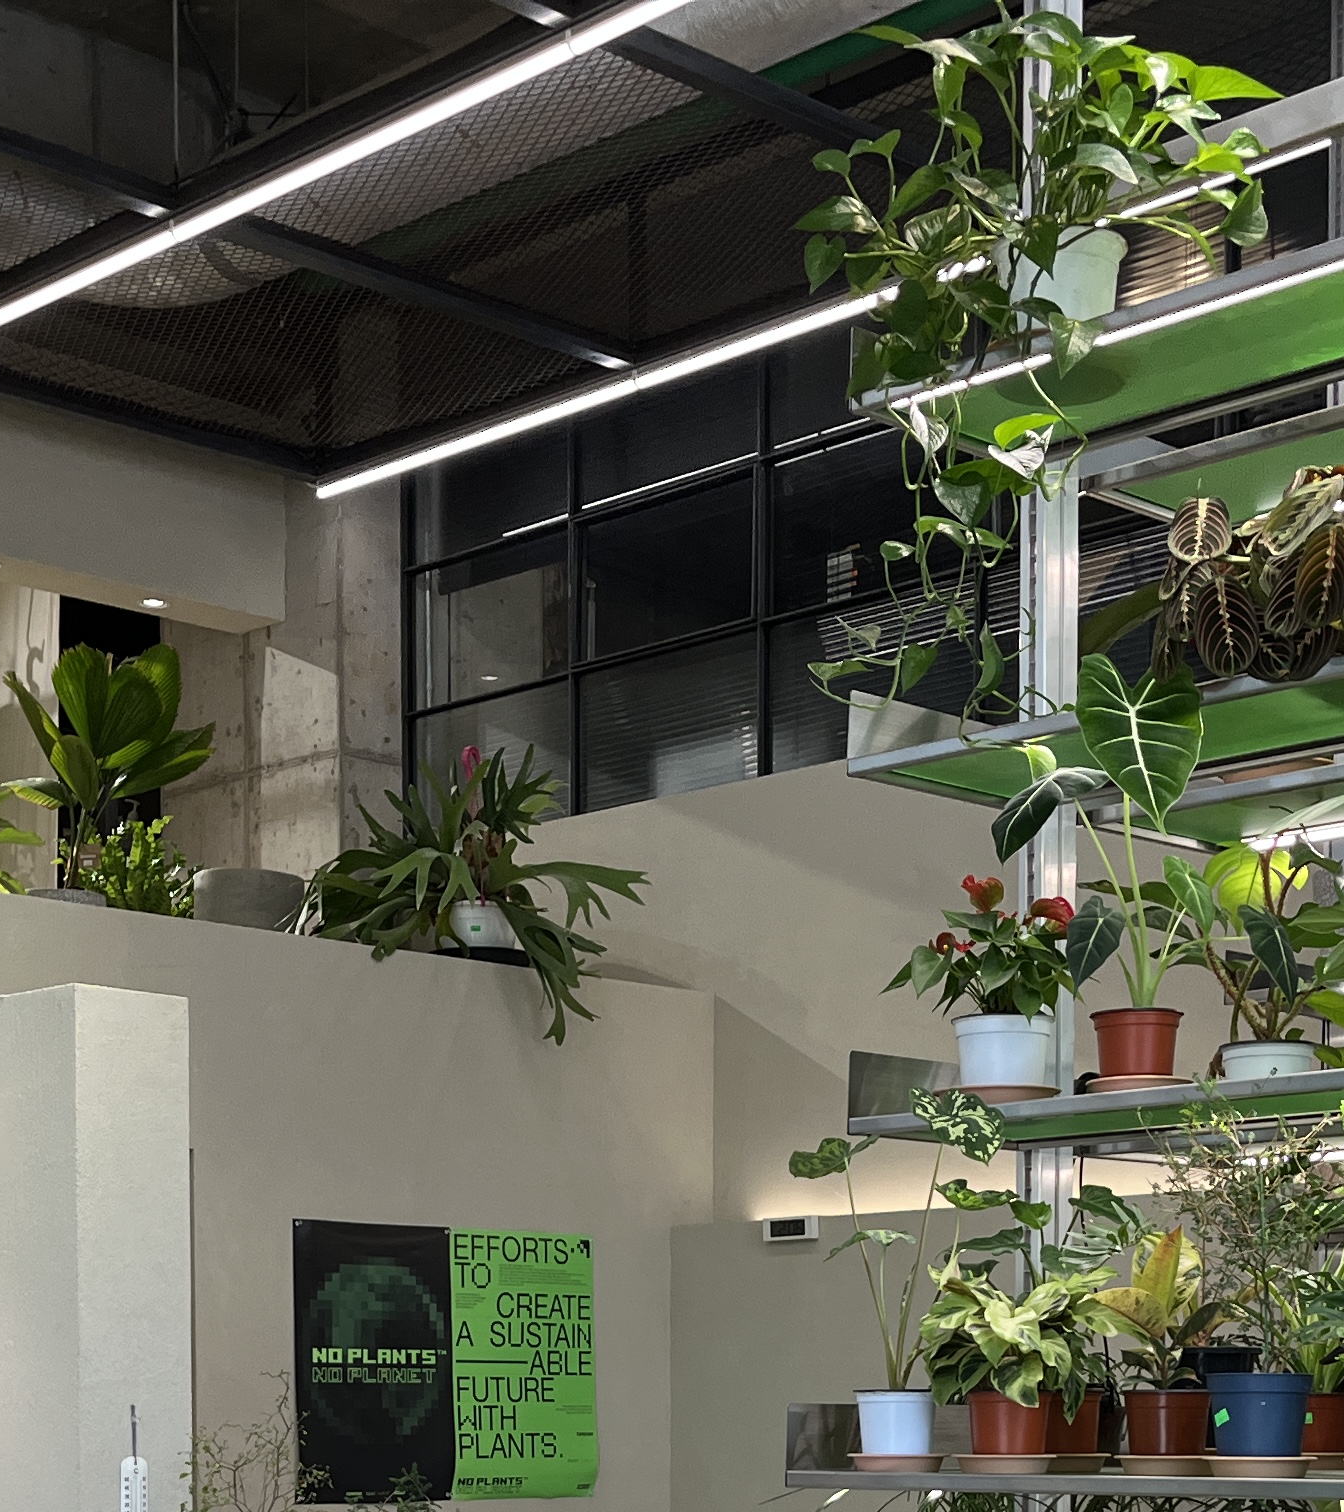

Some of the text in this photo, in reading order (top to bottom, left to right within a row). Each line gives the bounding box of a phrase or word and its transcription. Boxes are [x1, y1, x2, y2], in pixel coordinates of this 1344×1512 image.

[454, 1234, 569, 1265] EFFORTS
[454, 1261, 491, 1289] TO
[496, 1291, 591, 1320] CREATE
[456, 1320, 592, 1349] A SUSTAIN
[312, 1347, 343, 1364] NO
[529, 1350, 593, 1376] ABLE
[312, 1367, 436, 1384] NO PLANET
[457, 1376, 555, 1402] FUTURE
[457, 1405, 516, 1431] WITH
[458, 1432, 564, 1459] PLANTS.
[457, 1477, 474, 1486] NO
